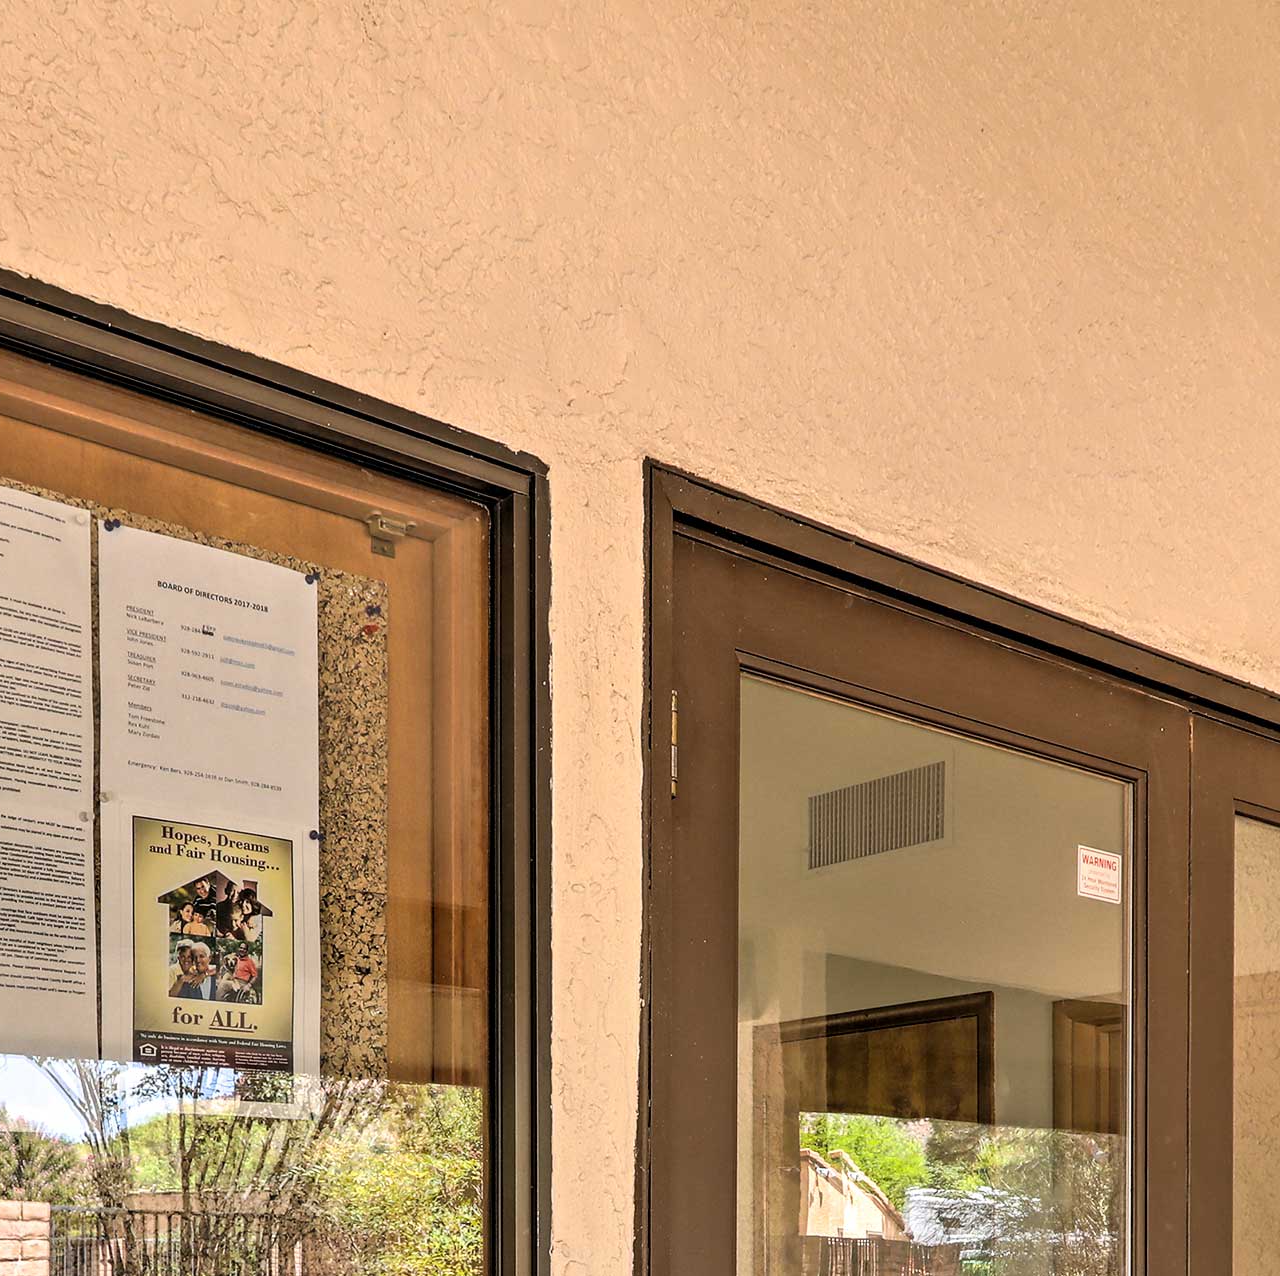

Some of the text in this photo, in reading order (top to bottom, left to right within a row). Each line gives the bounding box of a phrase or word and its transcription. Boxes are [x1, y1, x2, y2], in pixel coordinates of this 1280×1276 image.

[157, 580, 269, 613] BOARD OF DIRECTORS 2017-2018
[162, 825, 270, 854] Hopes, Dreams
[149, 844, 280, 871] and Fair Housing...
[1082, 854, 1117, 871] WARNING
[172, 1006, 258, 1032] for ALL.
